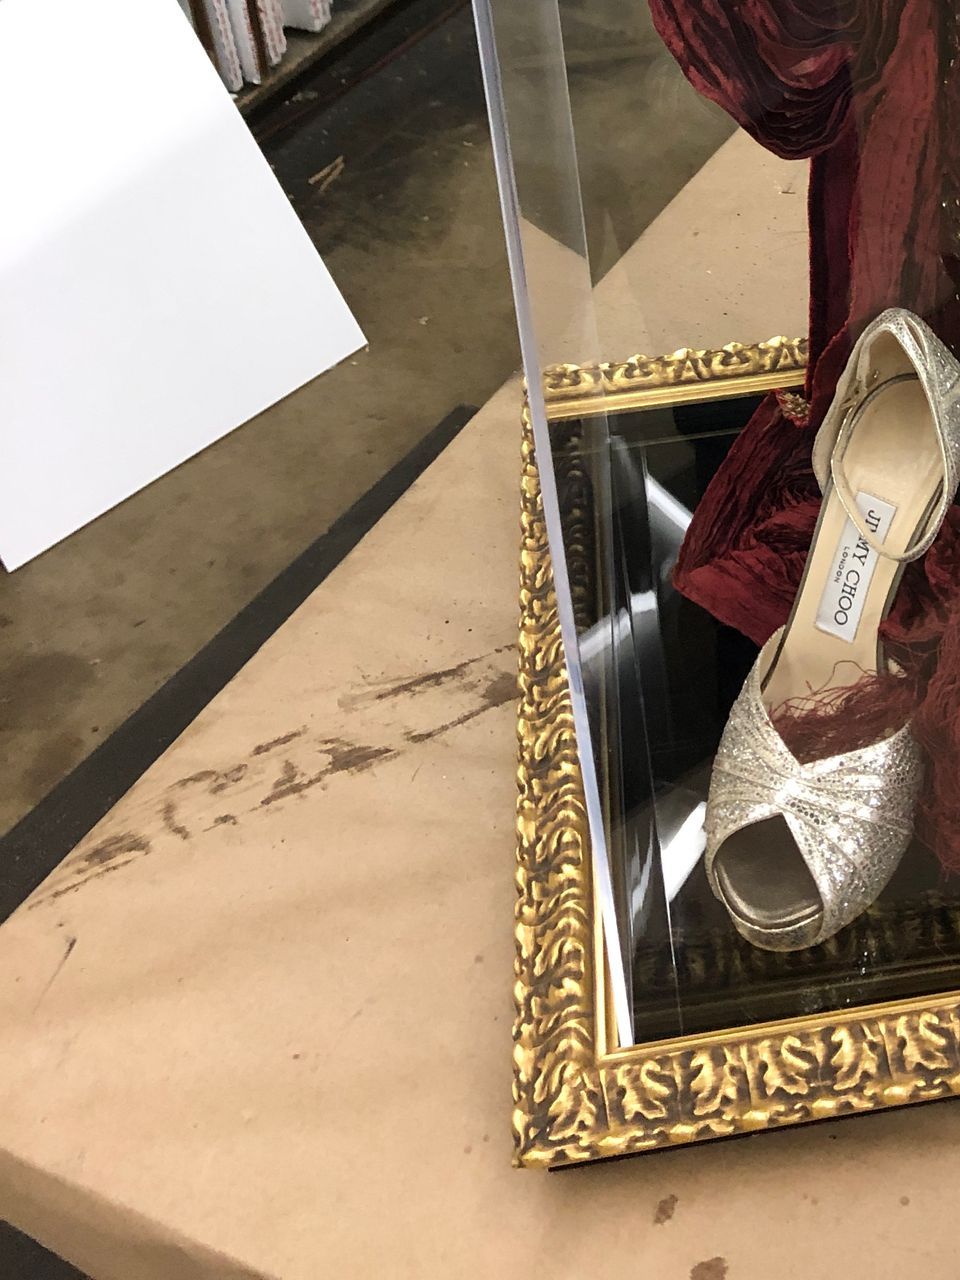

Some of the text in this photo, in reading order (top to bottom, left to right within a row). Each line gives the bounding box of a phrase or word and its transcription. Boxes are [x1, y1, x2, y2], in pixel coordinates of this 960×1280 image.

[834, 546, 850, 584] LONDON
[834, 509, 881, 626] JIMY CHOO
